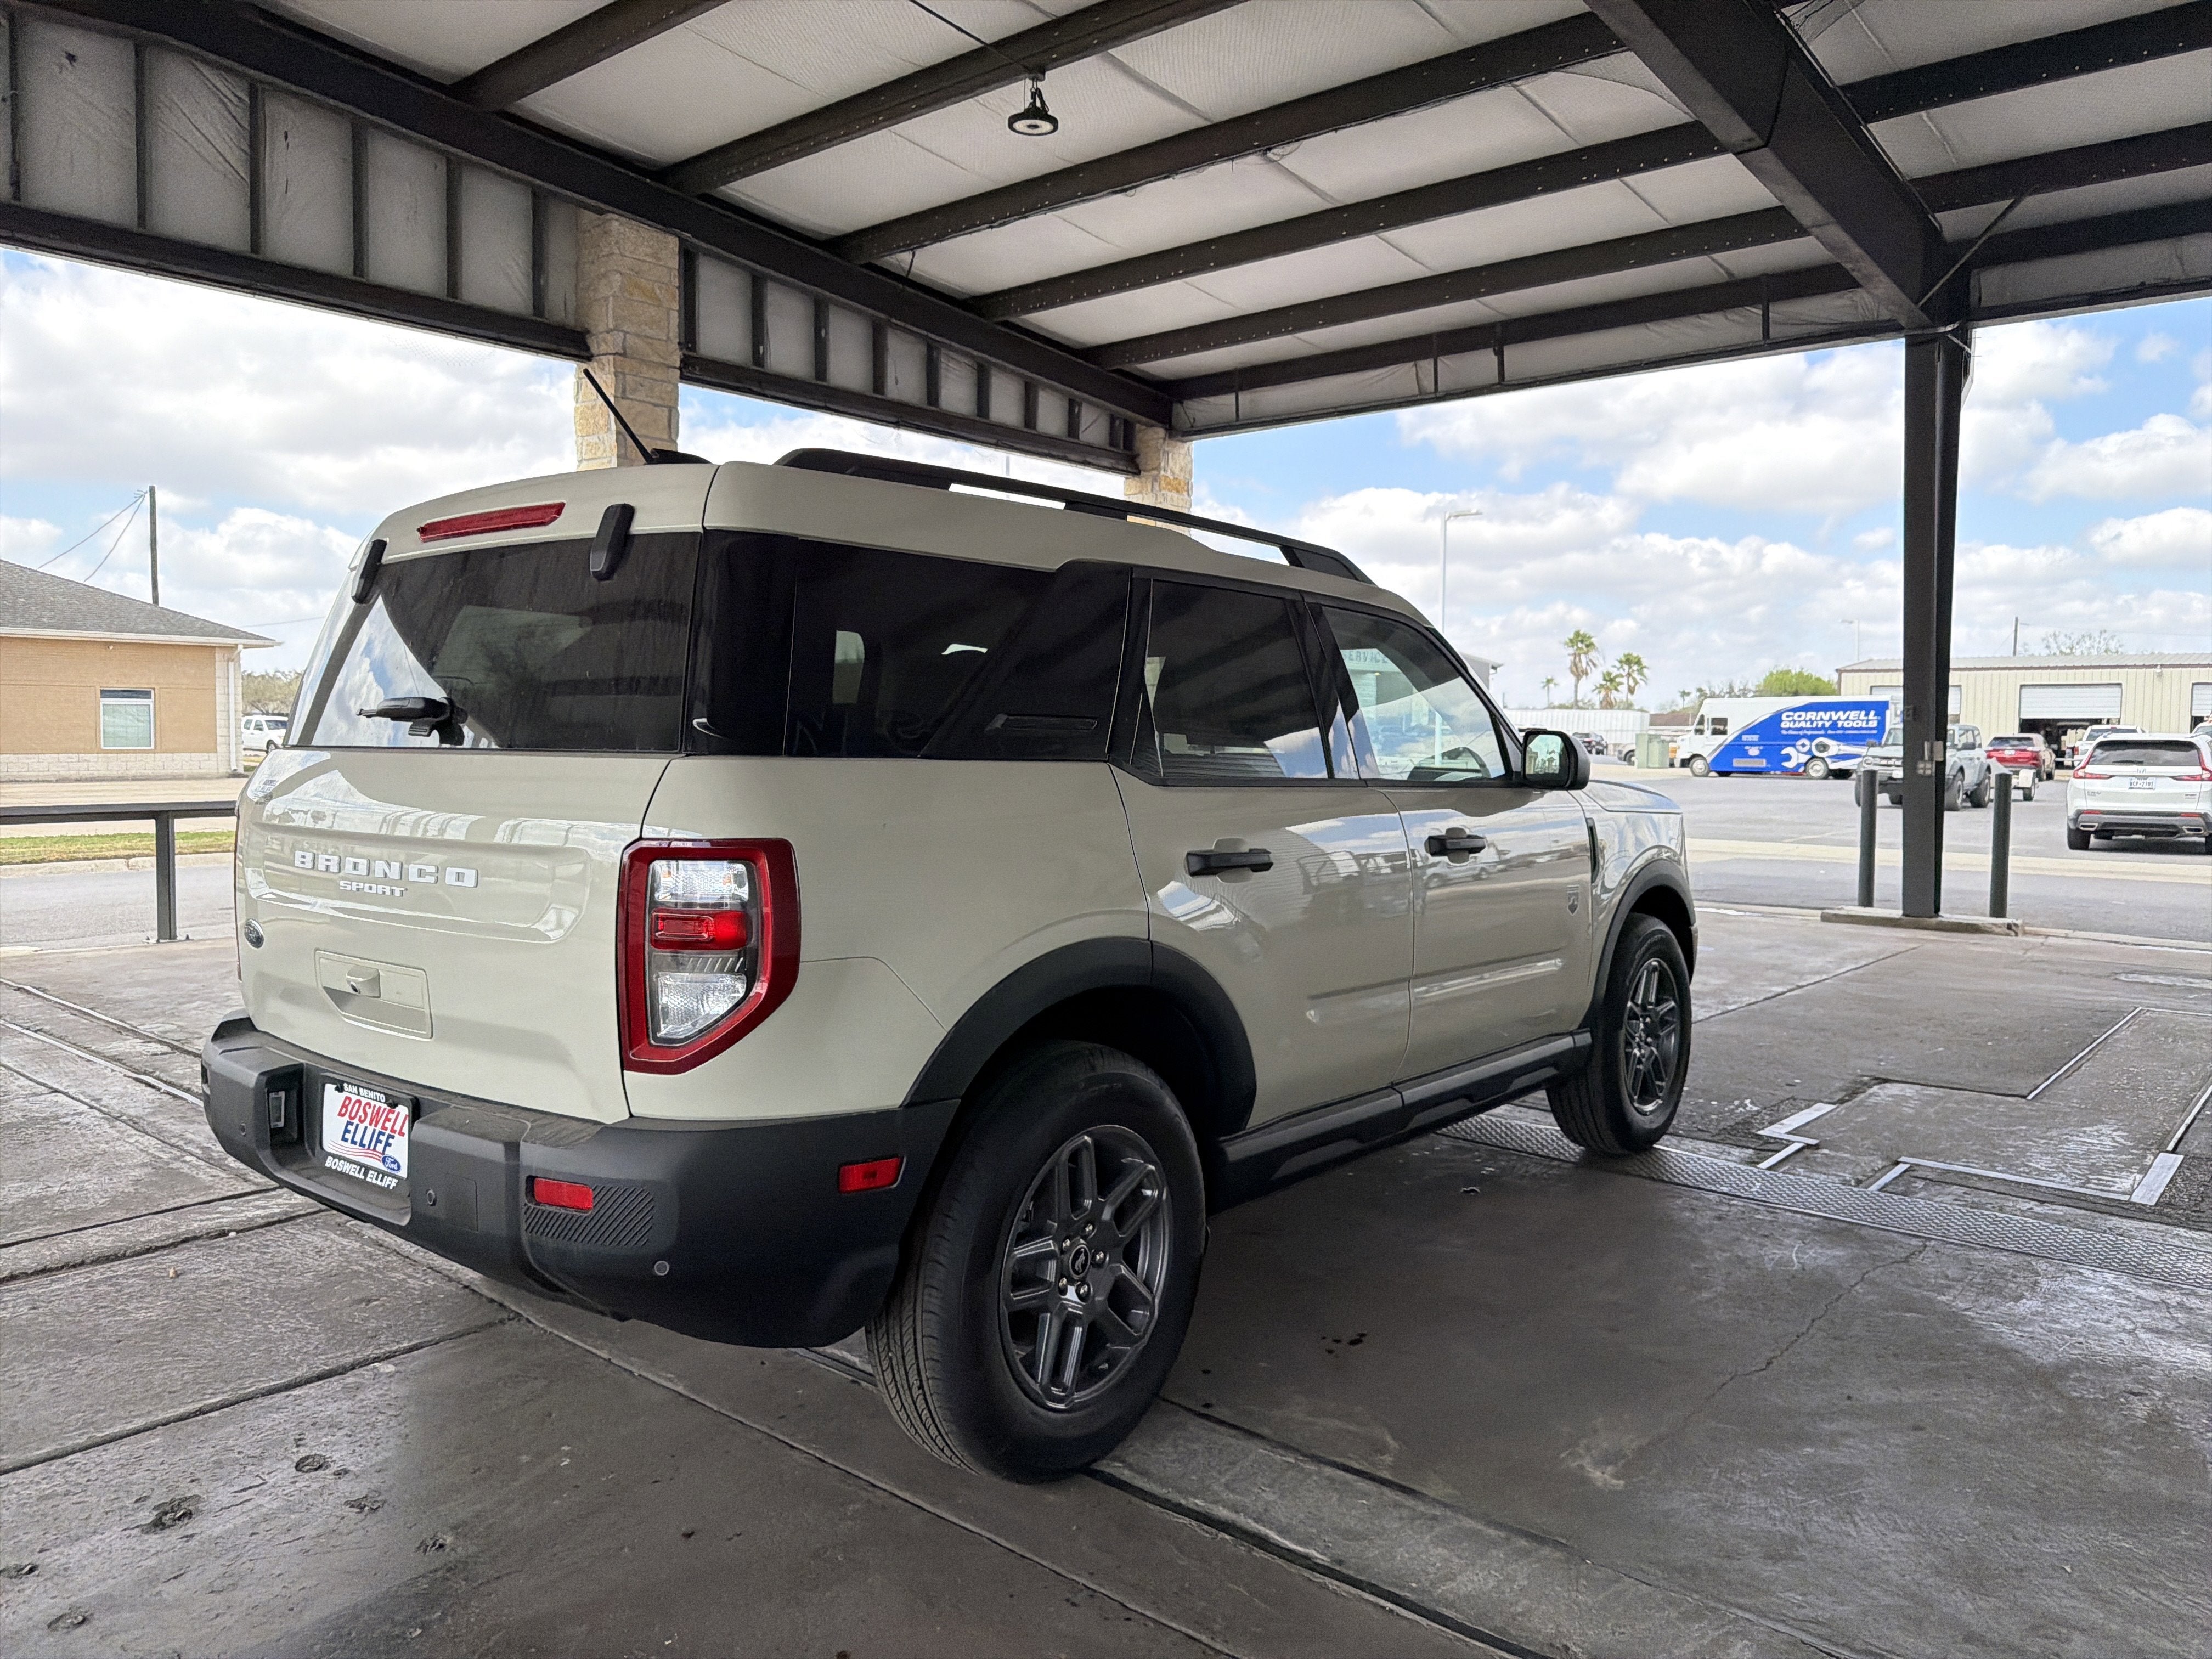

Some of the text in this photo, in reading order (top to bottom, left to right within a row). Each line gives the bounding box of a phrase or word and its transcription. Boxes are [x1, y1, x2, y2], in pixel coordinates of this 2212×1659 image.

[1780, 720, 1878, 729] QUALITY TOOLS
[1781, 710, 1878, 721] CORNWELL
[295, 850, 478, 888] BRONCO
[340, 881, 404, 897] SPORT
[343, 1082, 386, 1103] SAN BENITO
[337, 1096, 409, 1137] BOSWELL
[341, 1120, 396, 1155] ELLIFF
[325, 1156, 398, 1190] BOSWELL ELLIFF
[385, 1156, 398, 1171] Ford
